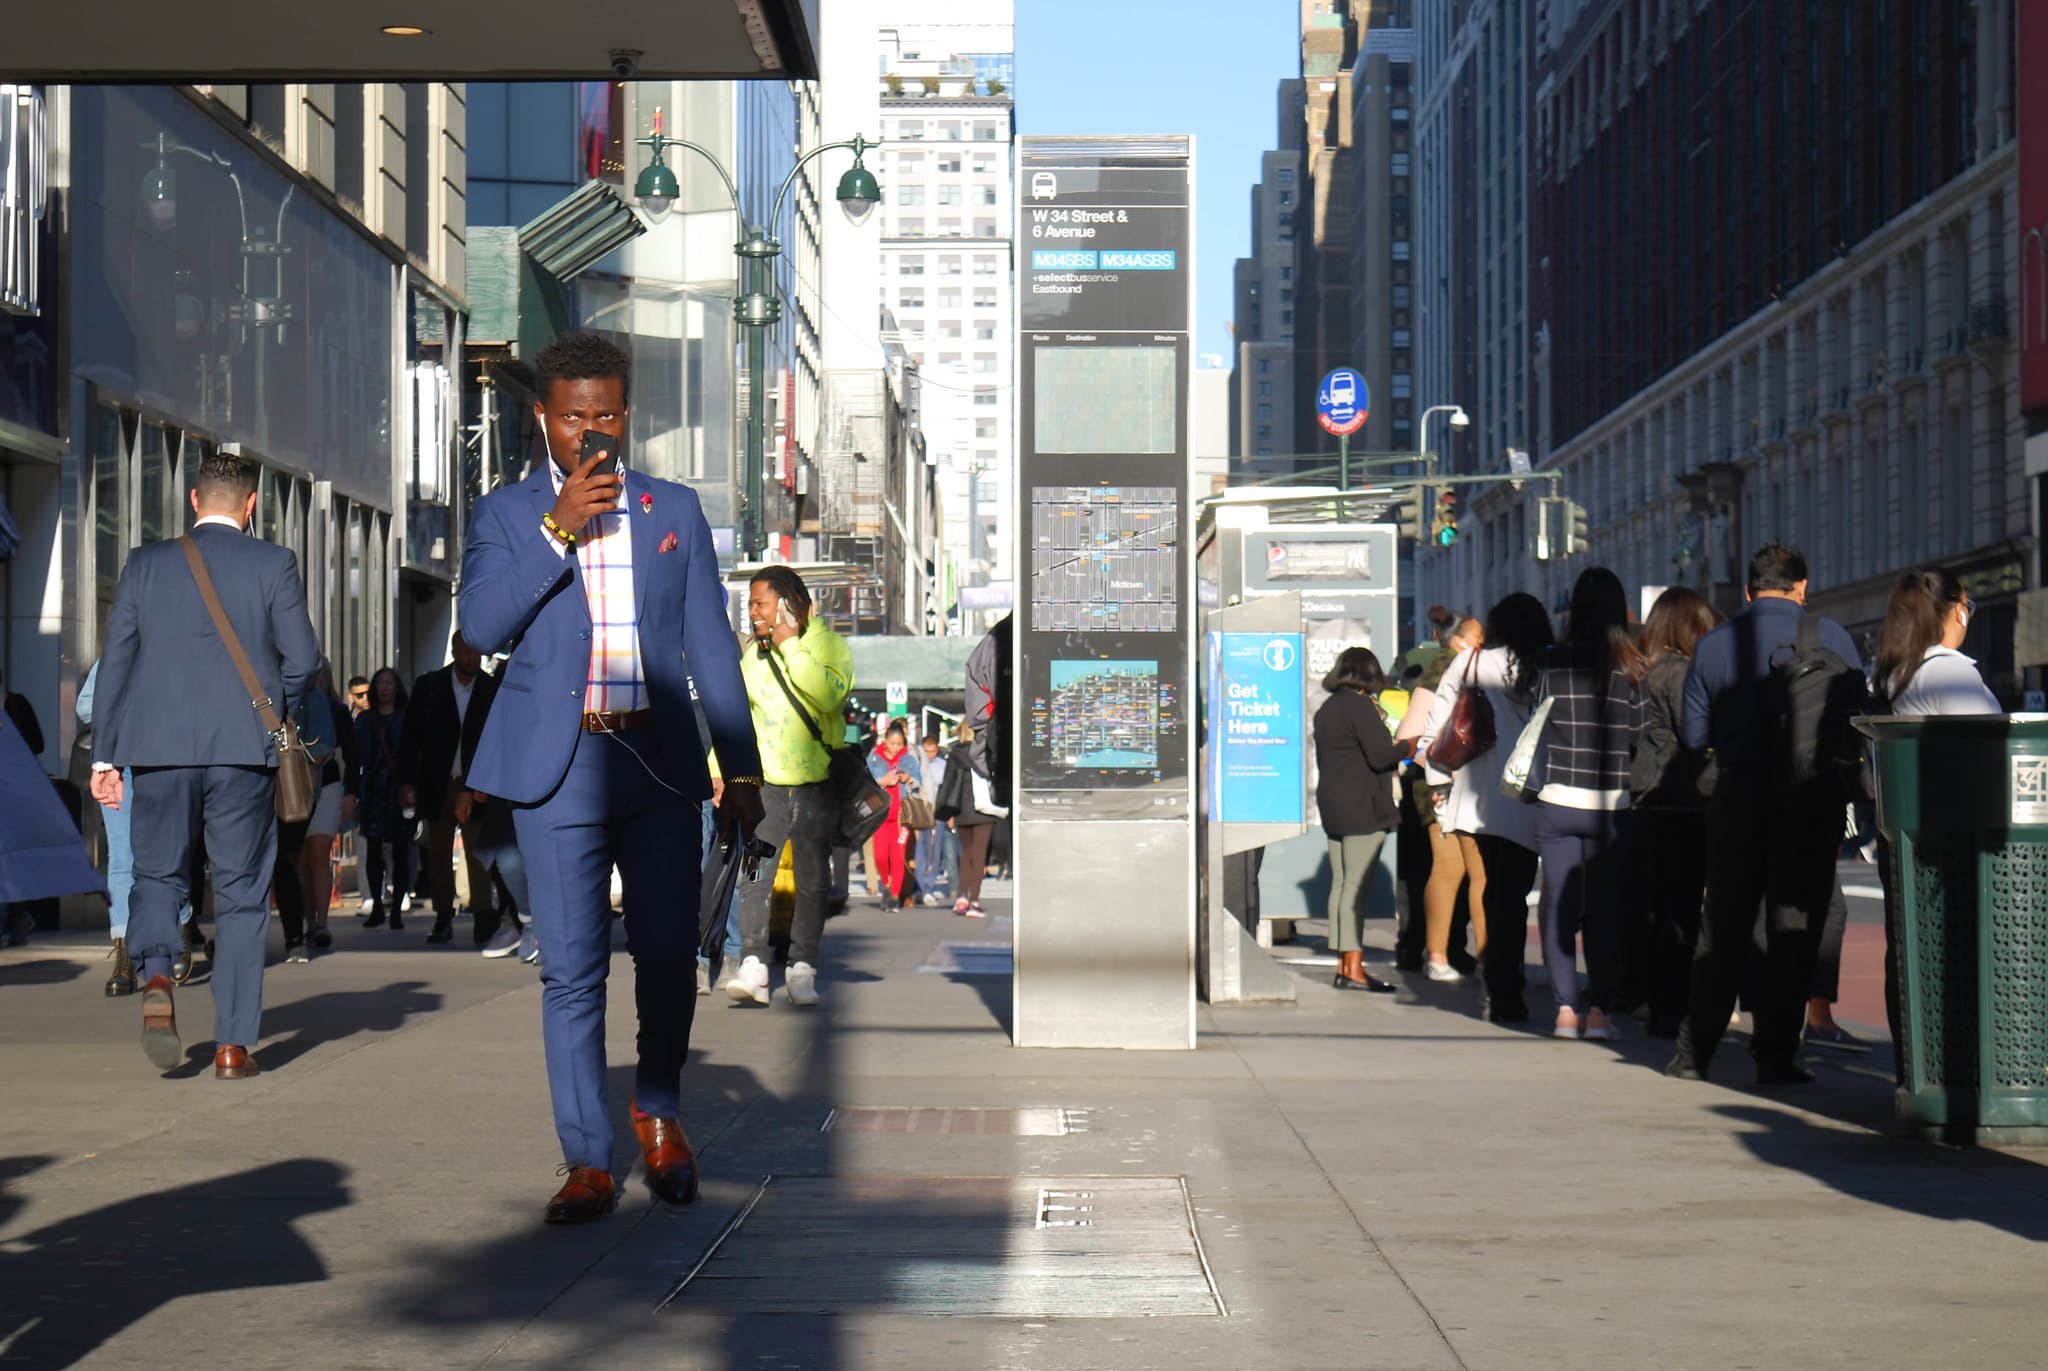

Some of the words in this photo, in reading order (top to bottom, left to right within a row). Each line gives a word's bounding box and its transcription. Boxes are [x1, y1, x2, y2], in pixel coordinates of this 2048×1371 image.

[1033, 210, 1048, 223] W
[1050, 210, 1069, 223] 34
[1072, 210, 1115, 223] Street
[1117, 210, 1129, 223] &
[1033, 225, 1042, 238] 6
[1044, 225, 1096, 238] Avenue
[1035, 254, 1094, 267] M34SBS
[1103, 254, 1172, 267] M34ASBS
[1033, 284, 1082, 294] Eastbound
[1228, 683, 1258, 699] Get
[1228, 702, 1280, 716] Ticket
[1228, 719, 1268, 735] Here
